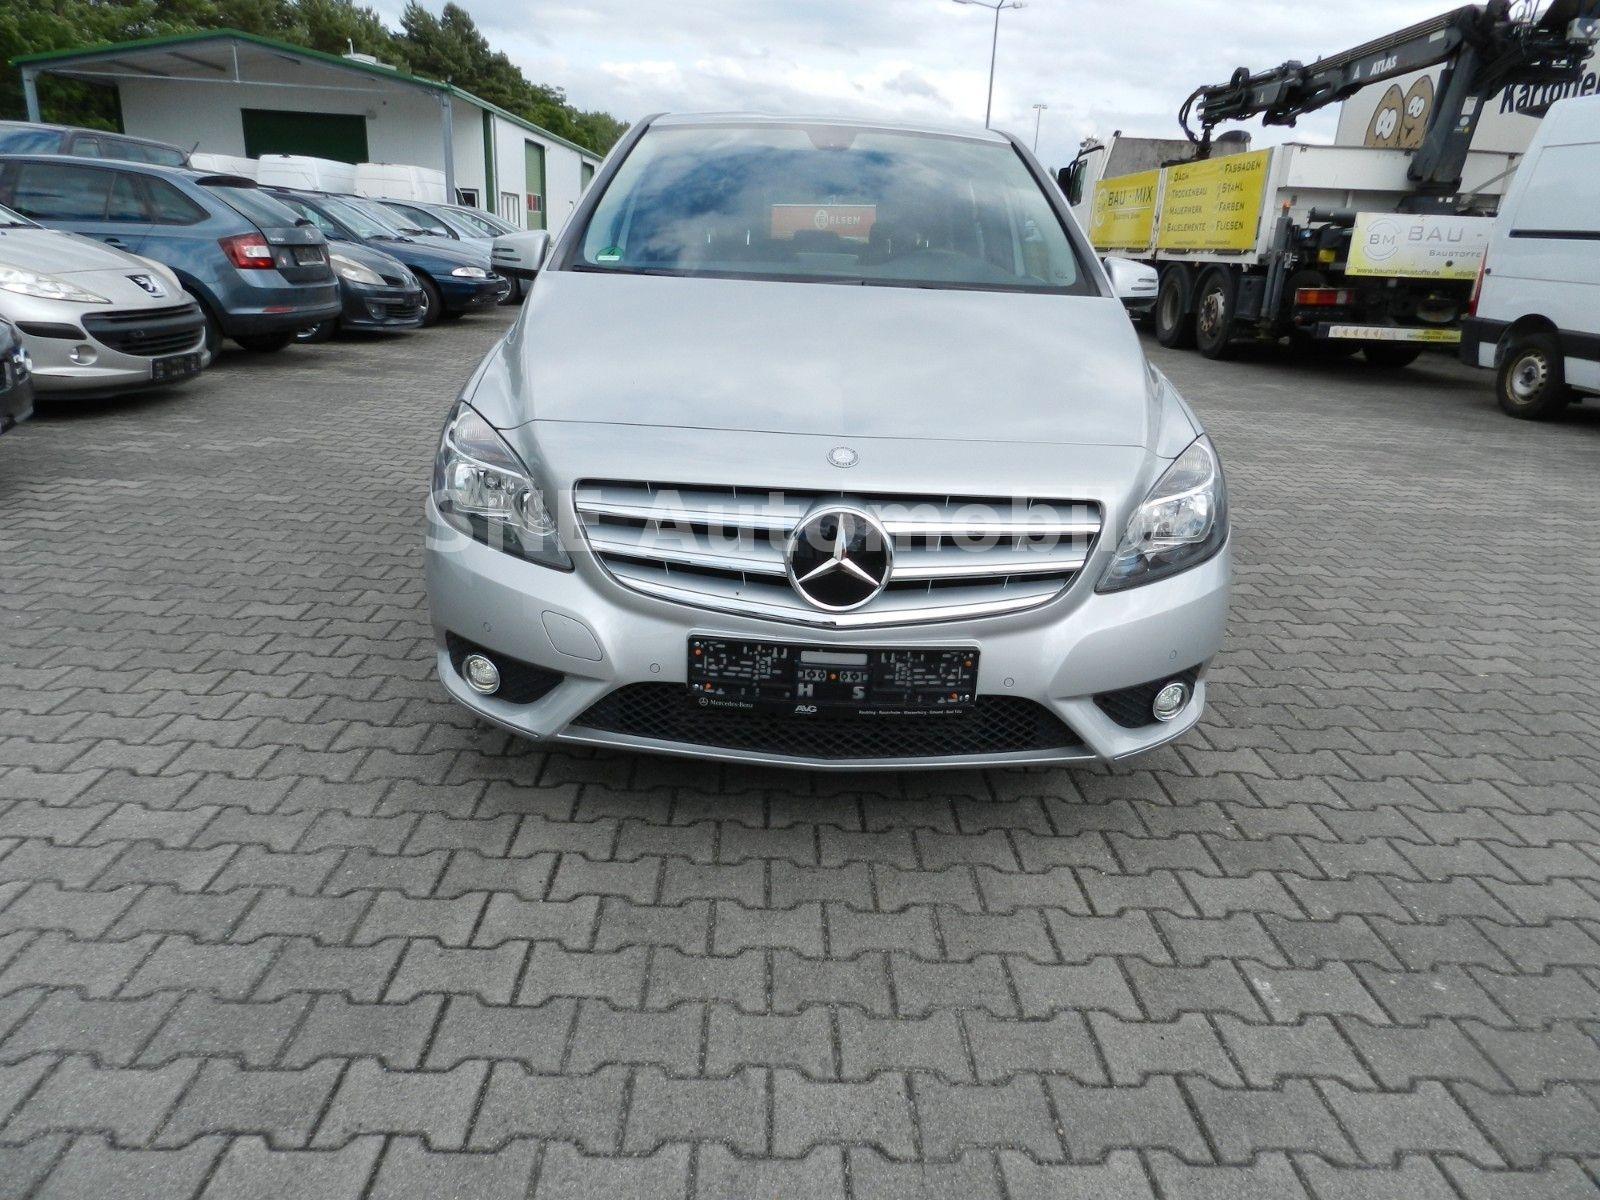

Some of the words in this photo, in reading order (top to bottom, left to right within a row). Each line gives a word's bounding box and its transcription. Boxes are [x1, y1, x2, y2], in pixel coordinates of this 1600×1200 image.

[1370, 55, 1398, 77] ATLAS
[1225, 160, 1262, 174] FASSADEN
[1221, 182, 1244, 194] STAHL
[1108, 190, 1127, 207] BAU
[1135, 185, 1154, 204] MIX
[1219, 202, 1246, 214] FARBEN
[1216, 220, 1245, 232] FLIESEN
[1369, 233, 1396, 246] BM
[1407, 225, 1465, 243] BAU
[710, 699, 754, 709] Mercedes-Benz
[795, 704, 818, 714] AVG
